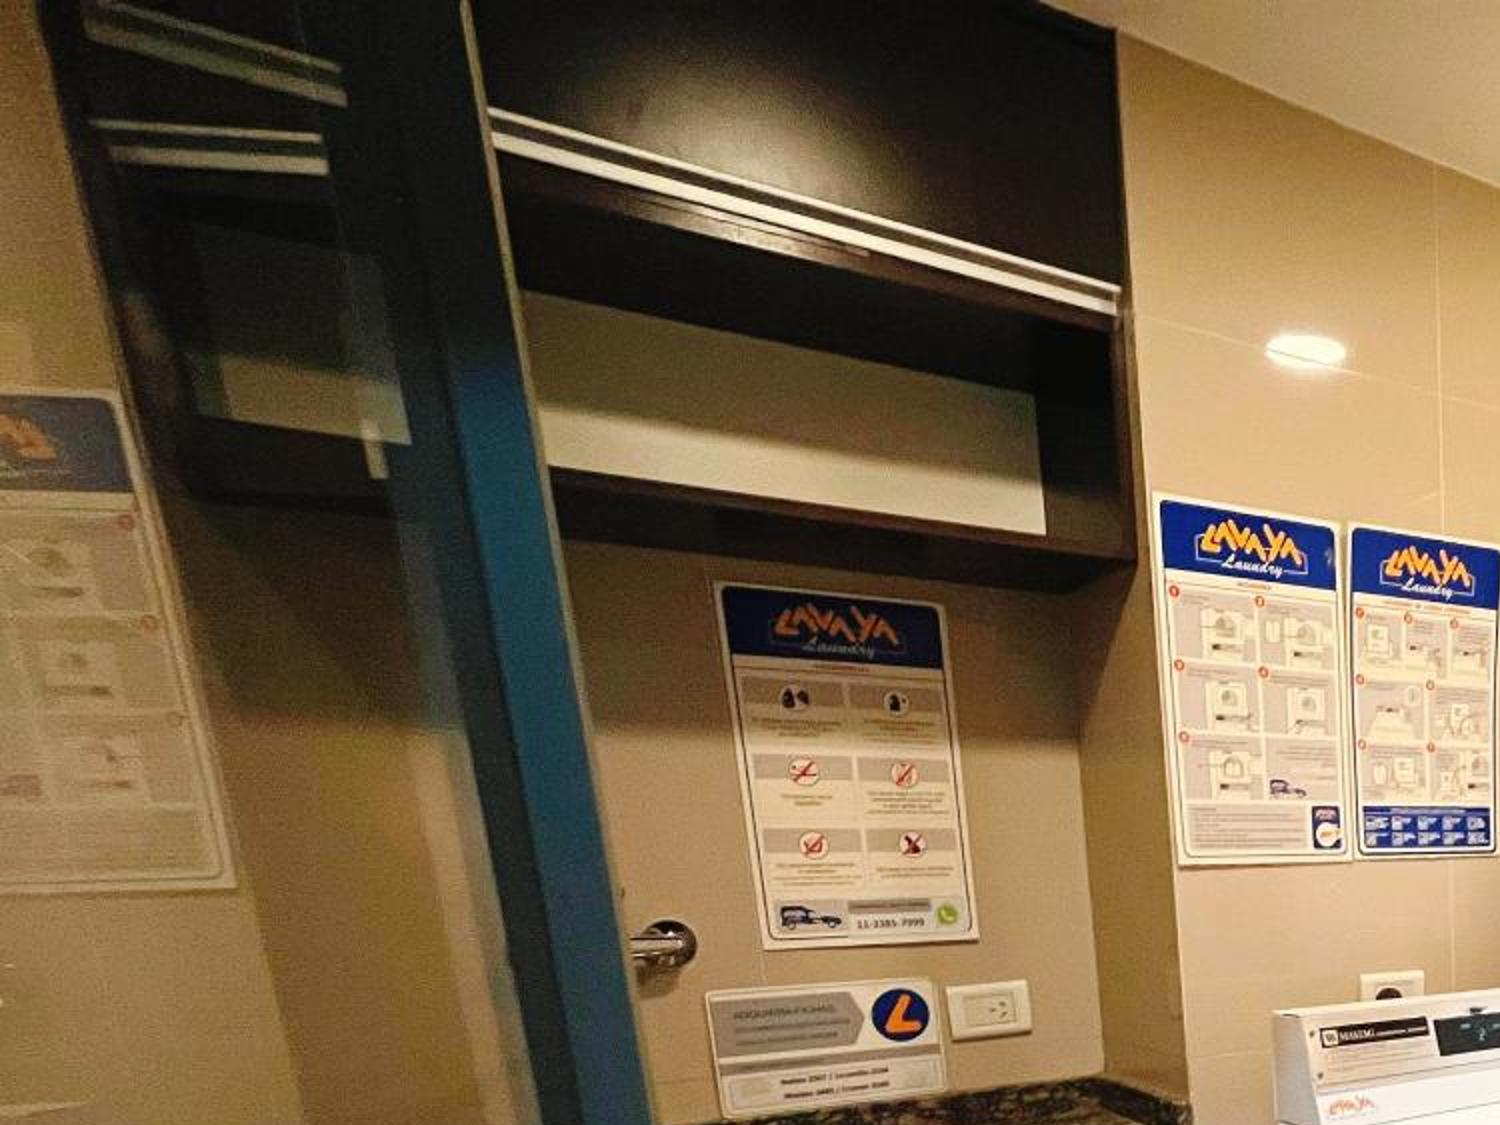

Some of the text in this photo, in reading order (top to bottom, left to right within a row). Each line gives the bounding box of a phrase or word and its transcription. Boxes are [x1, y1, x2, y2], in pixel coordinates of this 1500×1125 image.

[1199, 519, 1303, 565] LAVAYA
[1221, 553, 1283, 580] Laundry
[1384, 545, 1471, 588] LAVAYA
[1401, 577, 1453, 601] Laundry
[774, 601, 899, 647] LAVAYA
